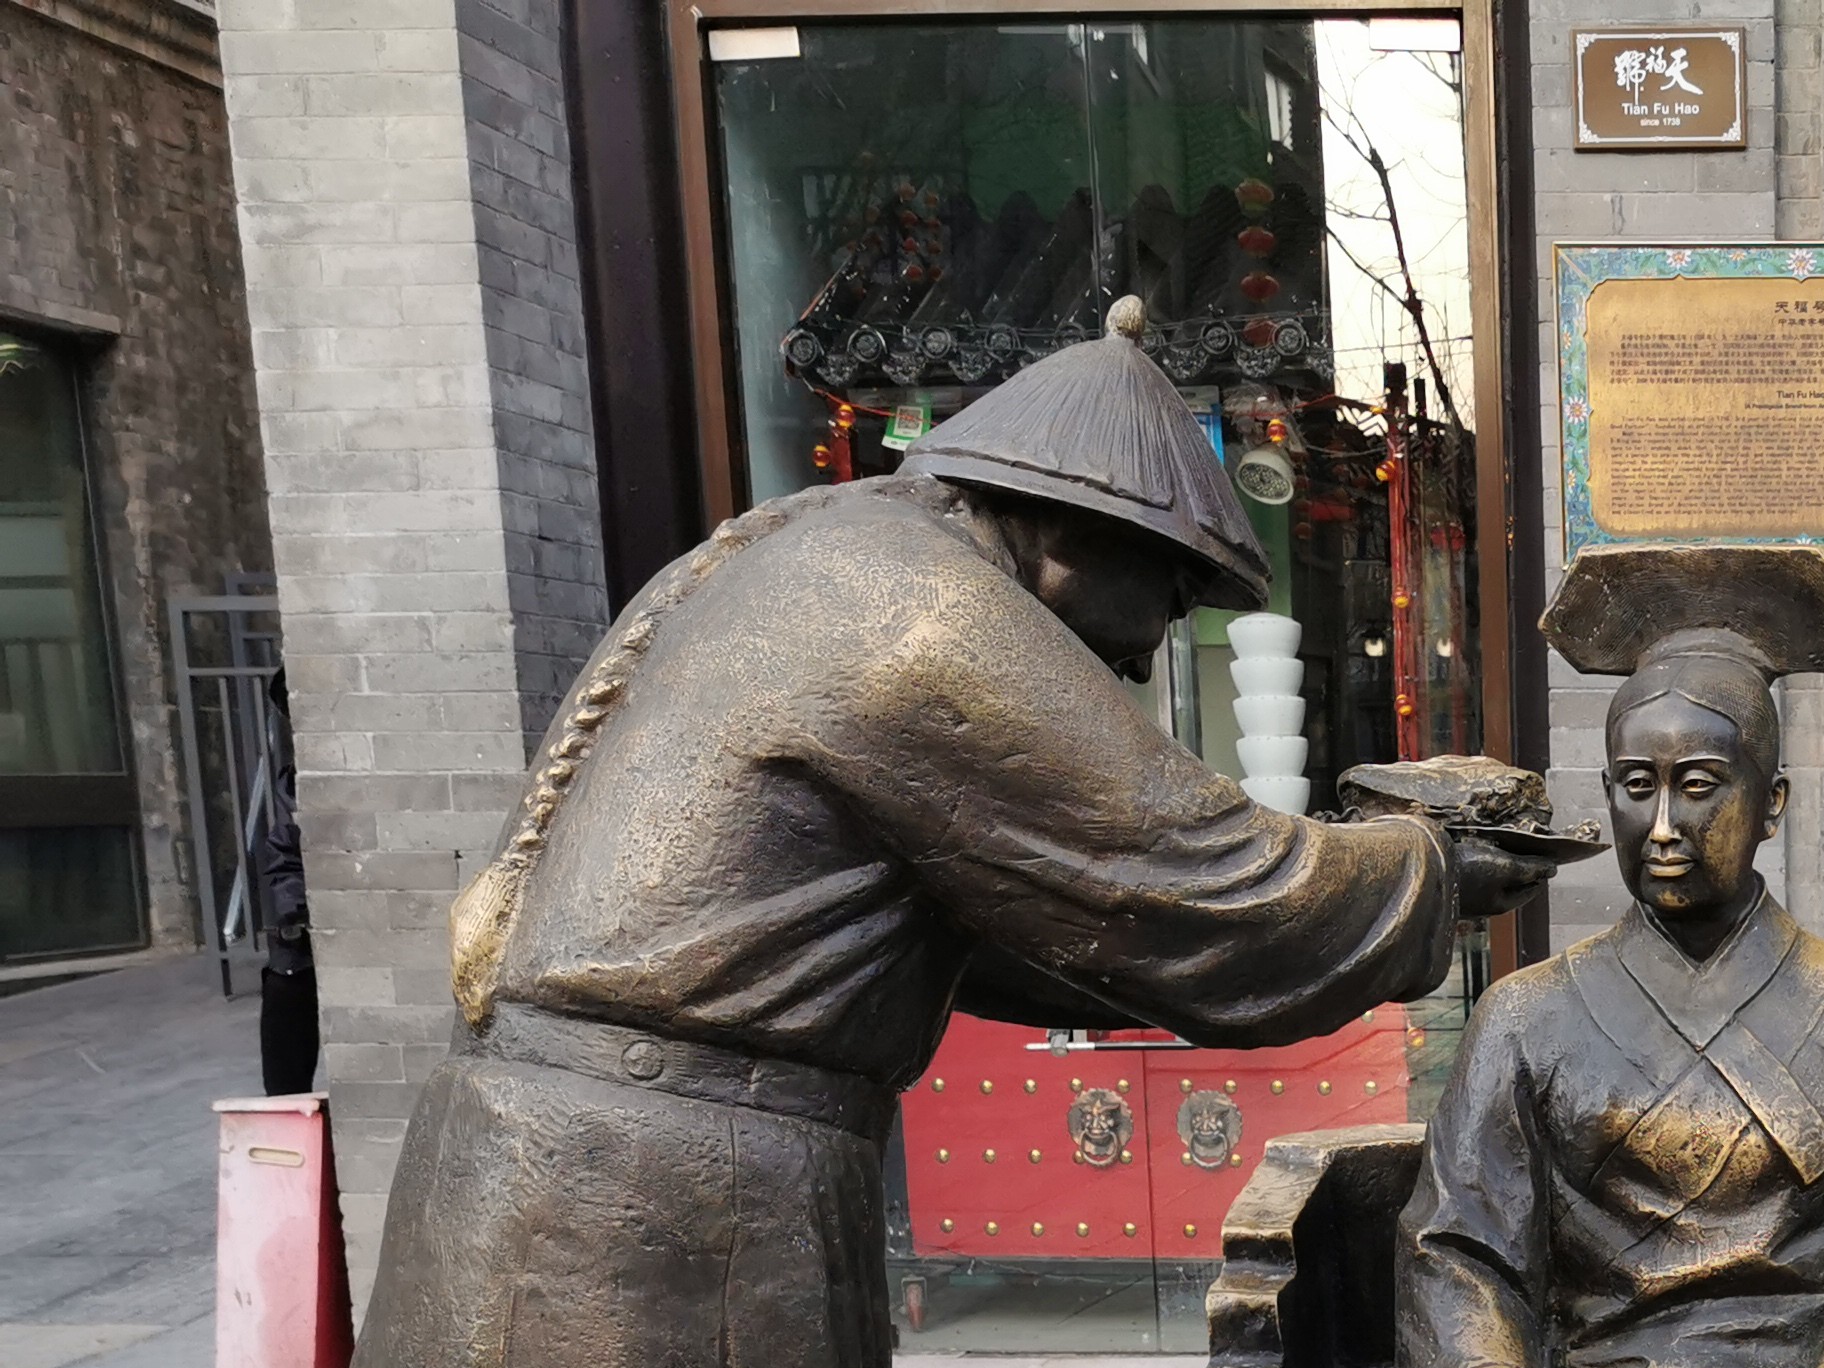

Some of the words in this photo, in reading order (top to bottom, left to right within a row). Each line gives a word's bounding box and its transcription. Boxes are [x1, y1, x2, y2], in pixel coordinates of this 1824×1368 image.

[1622, 102, 1648, 115] Tian
[1653, 102, 1670, 115] Fu
[1674, 102, 1700, 115] Hao
[1640, 117, 1660, 127] since
[1776, 390, 1794, 399] Tian
[1796, 390, 1808, 399] Fu
